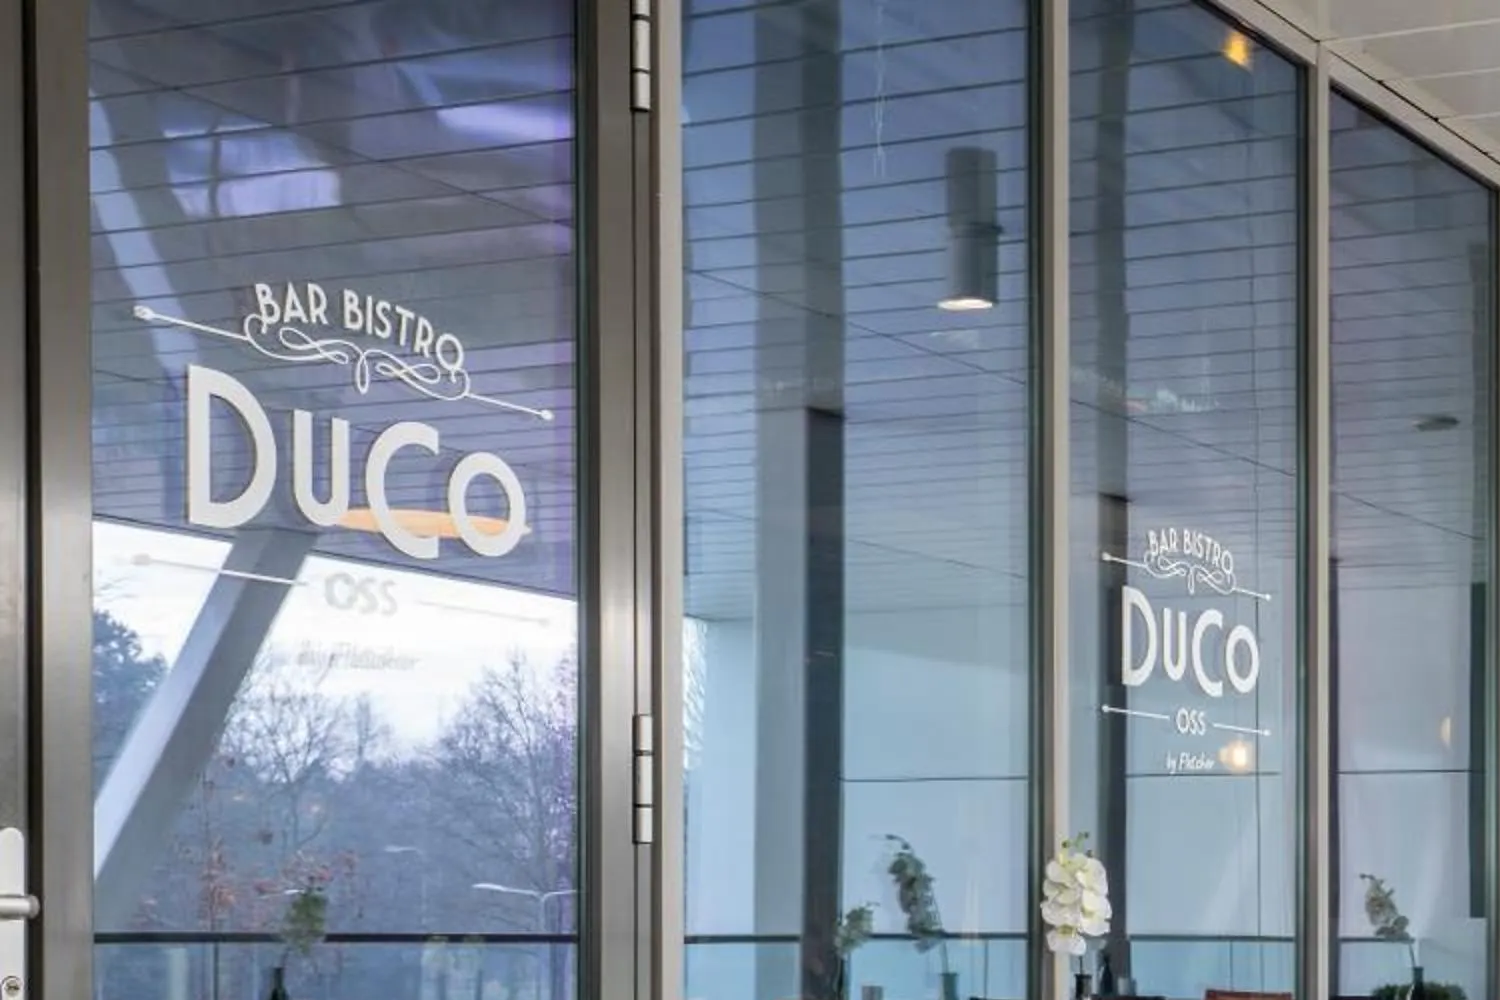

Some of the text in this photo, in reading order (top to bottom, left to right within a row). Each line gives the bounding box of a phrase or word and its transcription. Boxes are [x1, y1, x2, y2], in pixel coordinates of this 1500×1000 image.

[255, 282, 465, 383] BAR BISTRO
[1148, 527, 1234, 584] BAR BISTRO
[324, 572, 398, 617] OSS
[1175, 707, 1206, 736] OSS
